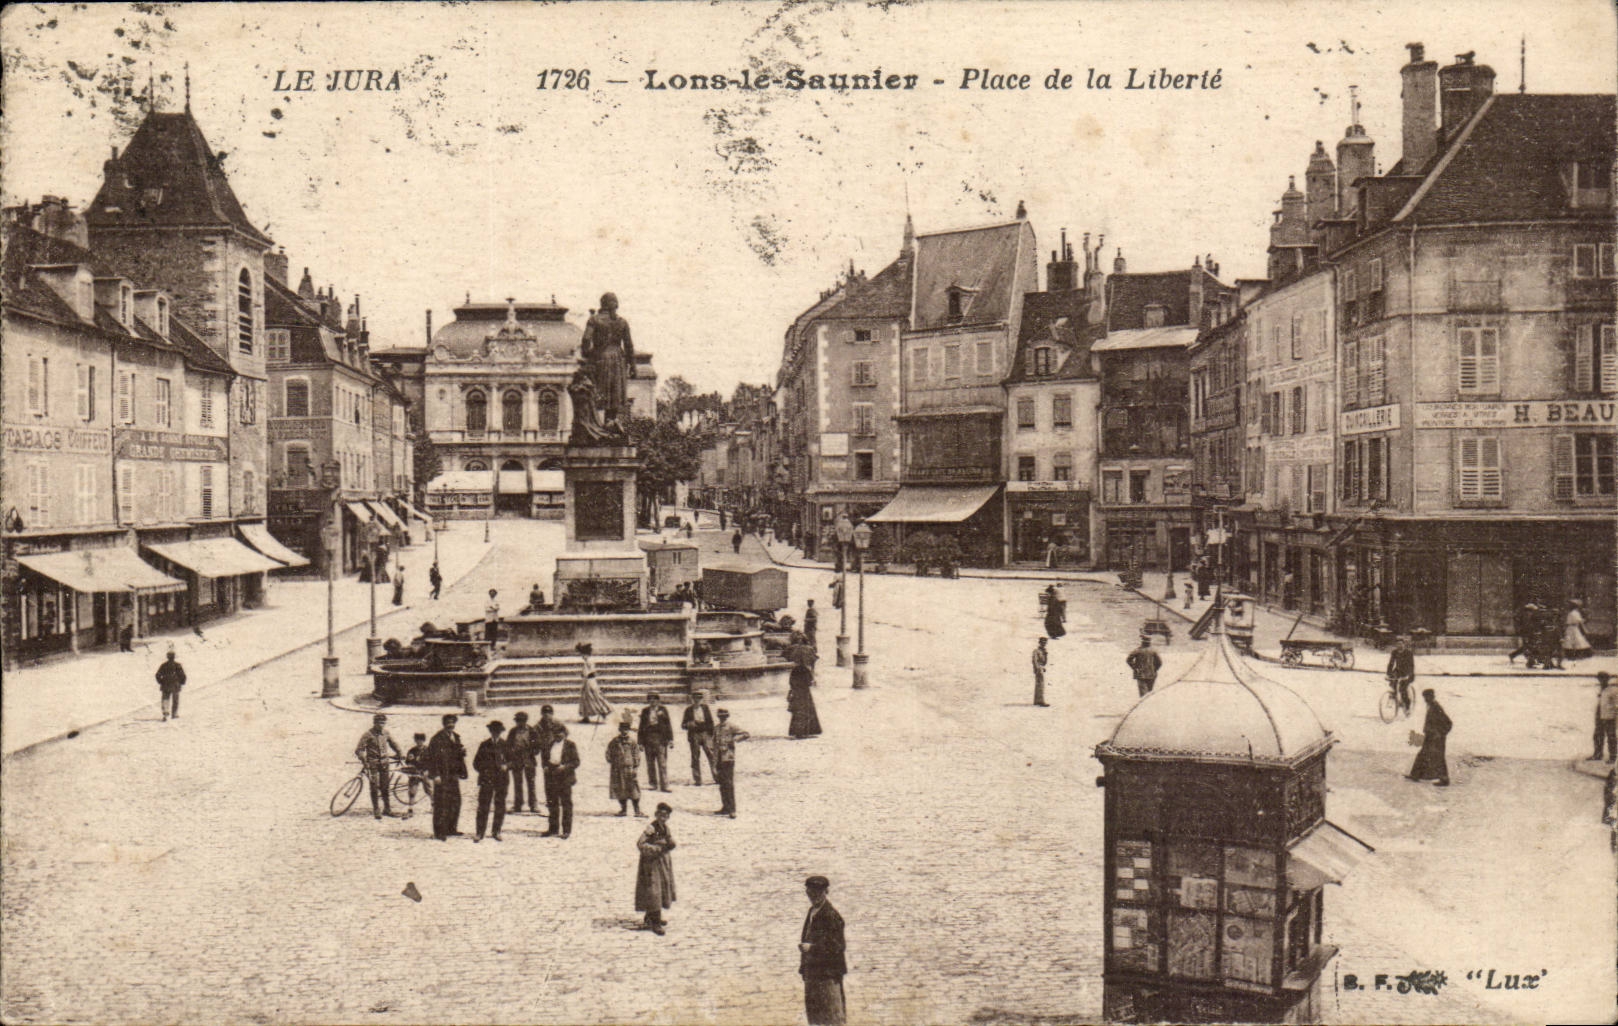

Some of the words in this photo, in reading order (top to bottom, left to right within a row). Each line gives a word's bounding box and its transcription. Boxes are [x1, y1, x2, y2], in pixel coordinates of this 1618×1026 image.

[1514, 403, 1538, 423] H.
[1546, 403, 1616, 423] BEAU
[5, 427, 61, 450] TABACS
